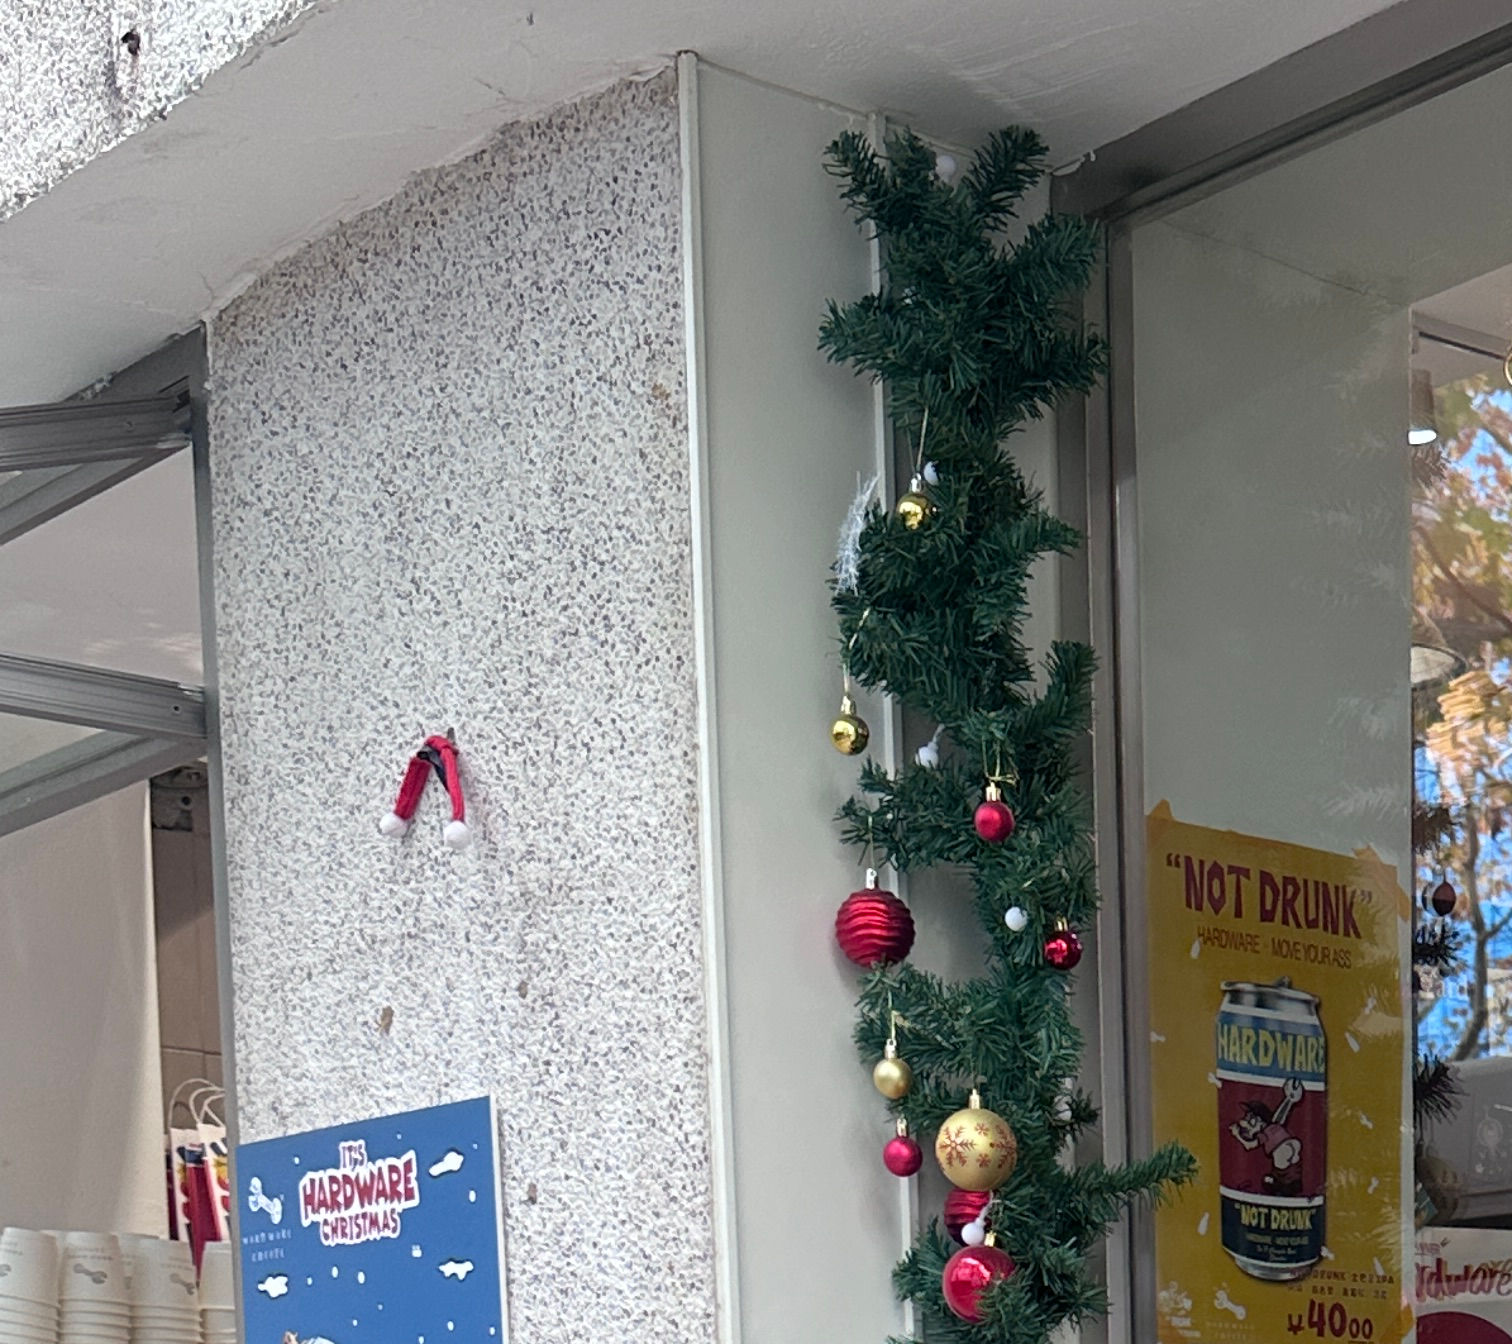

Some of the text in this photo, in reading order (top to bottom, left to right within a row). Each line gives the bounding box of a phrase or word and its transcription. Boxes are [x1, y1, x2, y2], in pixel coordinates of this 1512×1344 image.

[1197, 926, 1260, 954] HARDWARE
[1217, 1022, 1325, 1073] HARDWARE
[302, 1158, 415, 1221] HARDWARE
[322, 1208, 398, 1241] CHRISTMAS
